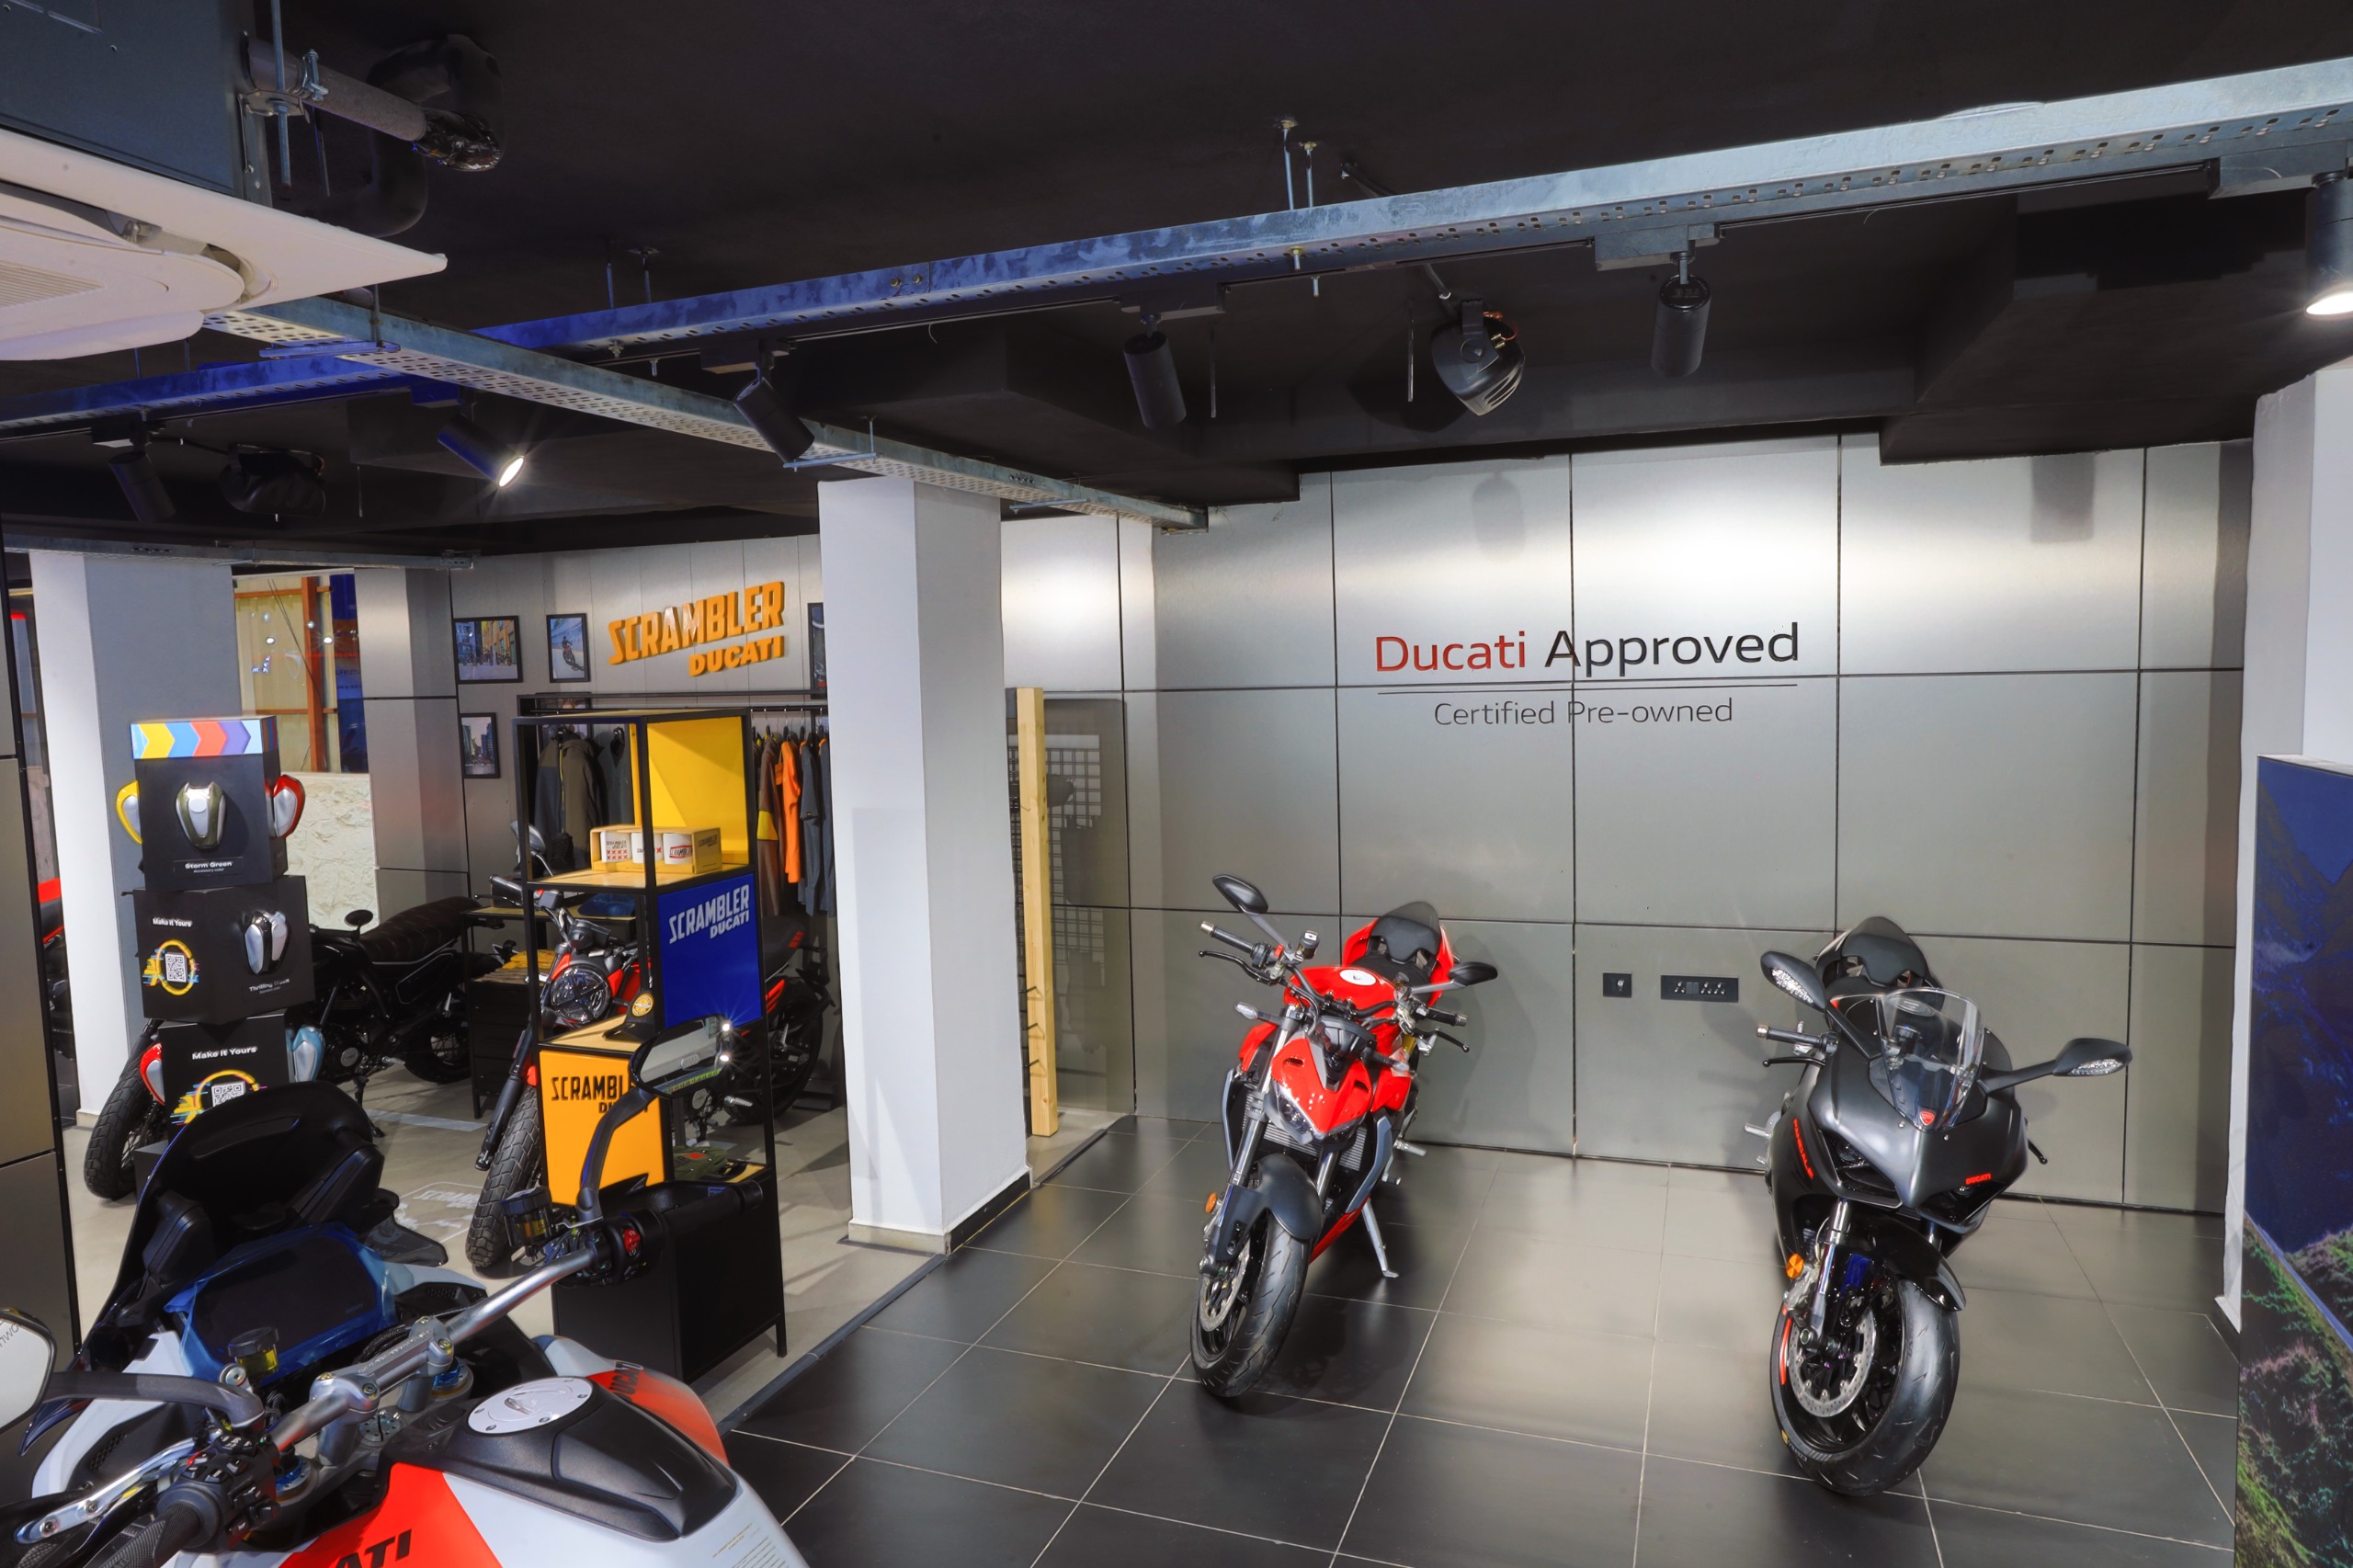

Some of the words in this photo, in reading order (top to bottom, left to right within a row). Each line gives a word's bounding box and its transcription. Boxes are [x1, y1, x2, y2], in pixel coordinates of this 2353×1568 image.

[608, 581, 785, 665] SCRAMBLER
[689, 635, 785, 677] DUCATI
[1376, 631, 1526, 672] Ducati
[1544, 621, 1798, 677] Approved
[1435, 700, 1554, 725] Certified
[1567, 697, 1733, 724] Pre-owned
[669, 884, 749, 944] SCRAMBLER
[710, 910, 749, 939] DUCATI
[192, 1051, 219, 1060] Make
[229, 1046, 257, 1056] Yours
[551, 1075, 624, 1101] SCRAMBL
[1965, 1173, 1993, 1186] DUCATI
